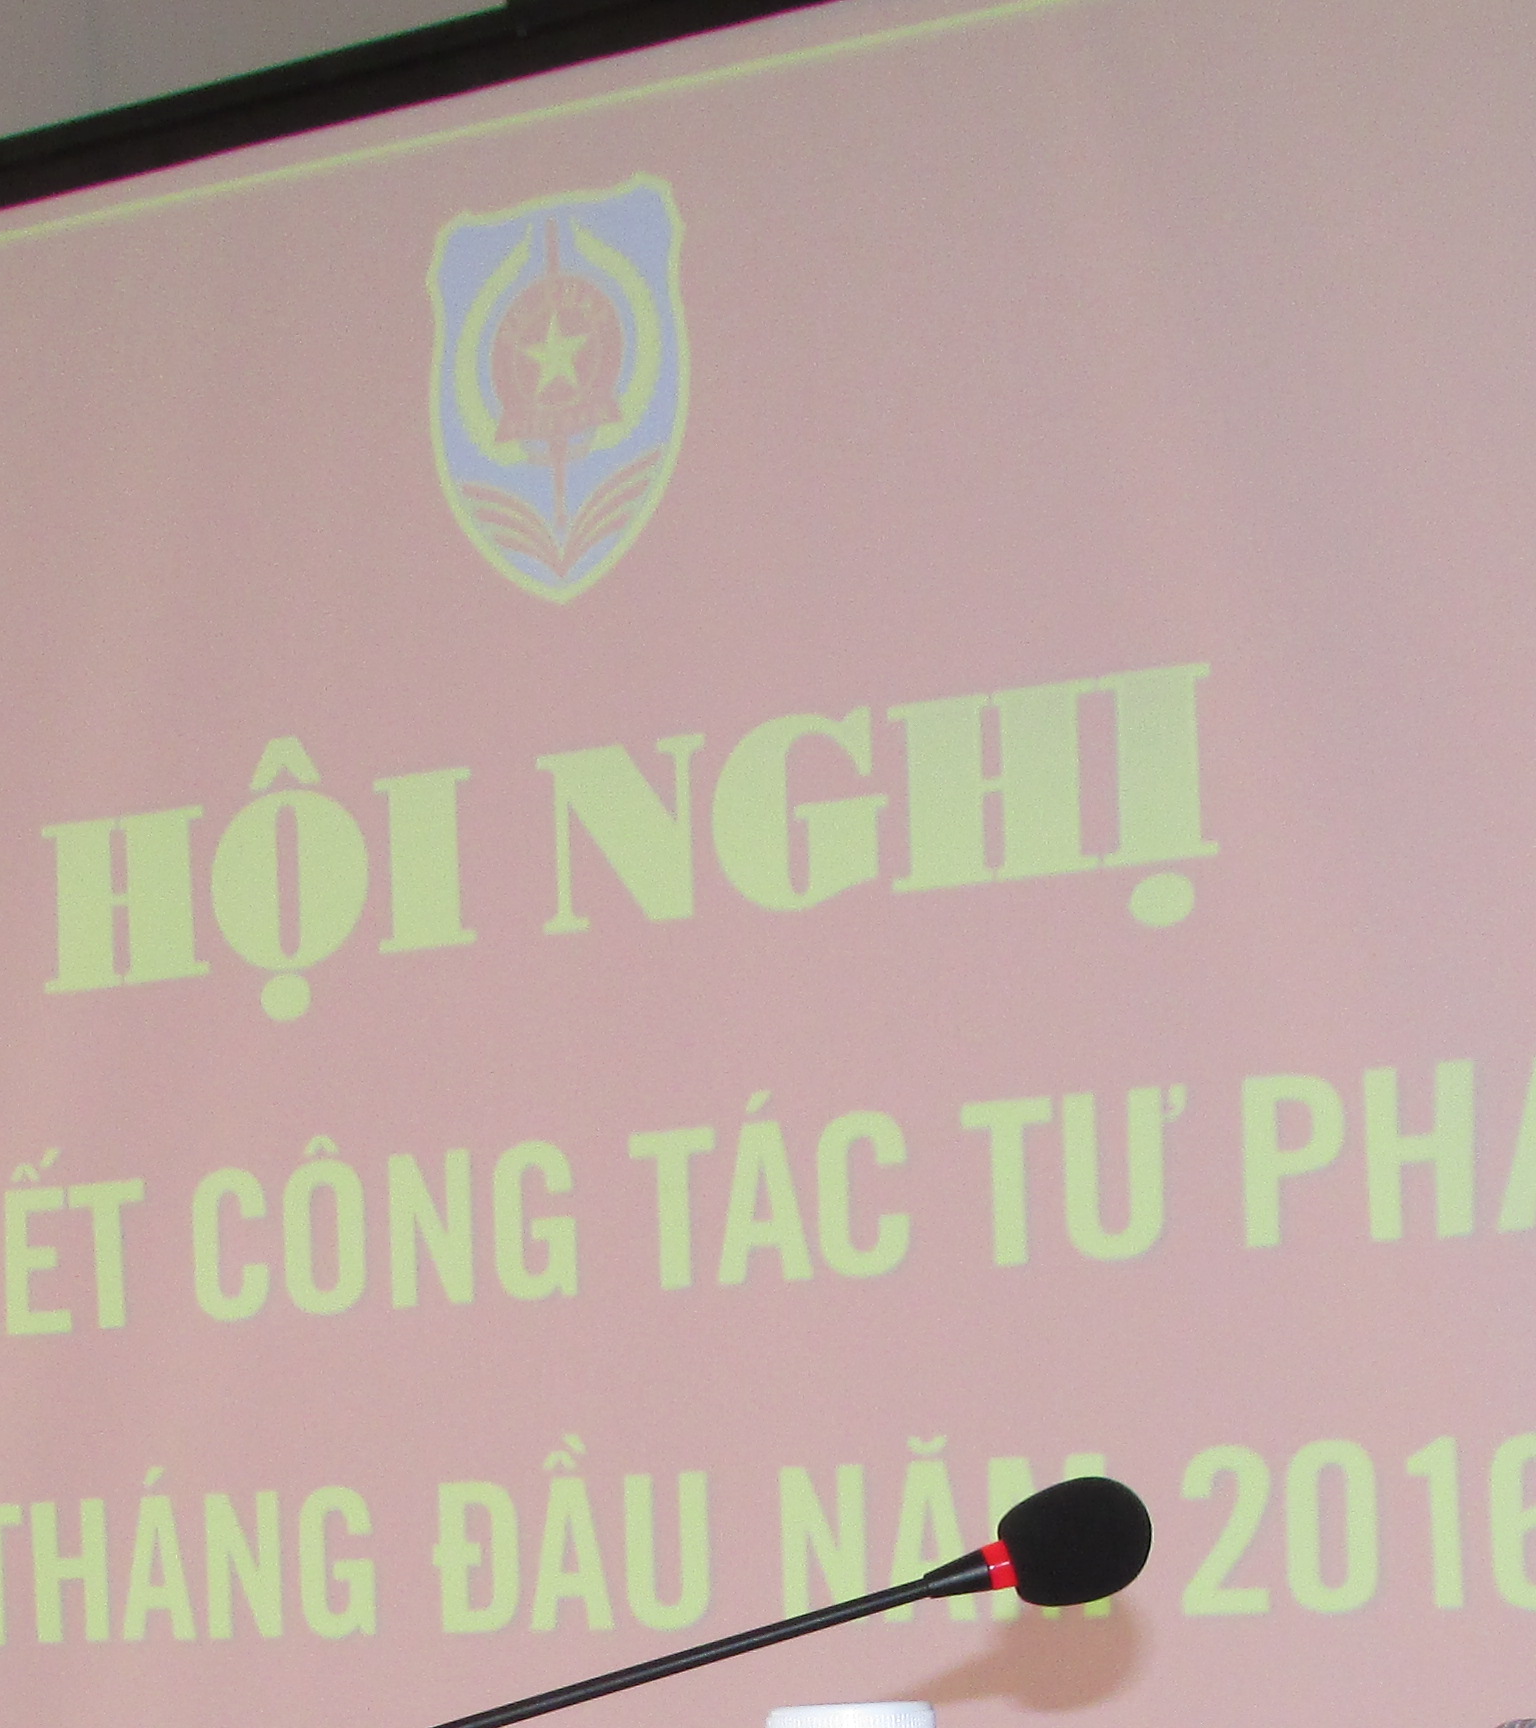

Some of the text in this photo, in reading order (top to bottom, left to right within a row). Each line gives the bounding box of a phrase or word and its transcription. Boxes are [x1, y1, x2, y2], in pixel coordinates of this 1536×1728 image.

[42, 662, 1220, 1021] HỘI NGHỊ
[192, 1136, 579, 1322] CÔNG
[629, 1091, 911, 1290] TÁC
[959, 1083, 1187, 1267] TƯ
[433, 1434, 712, 1635] ĐẦU
